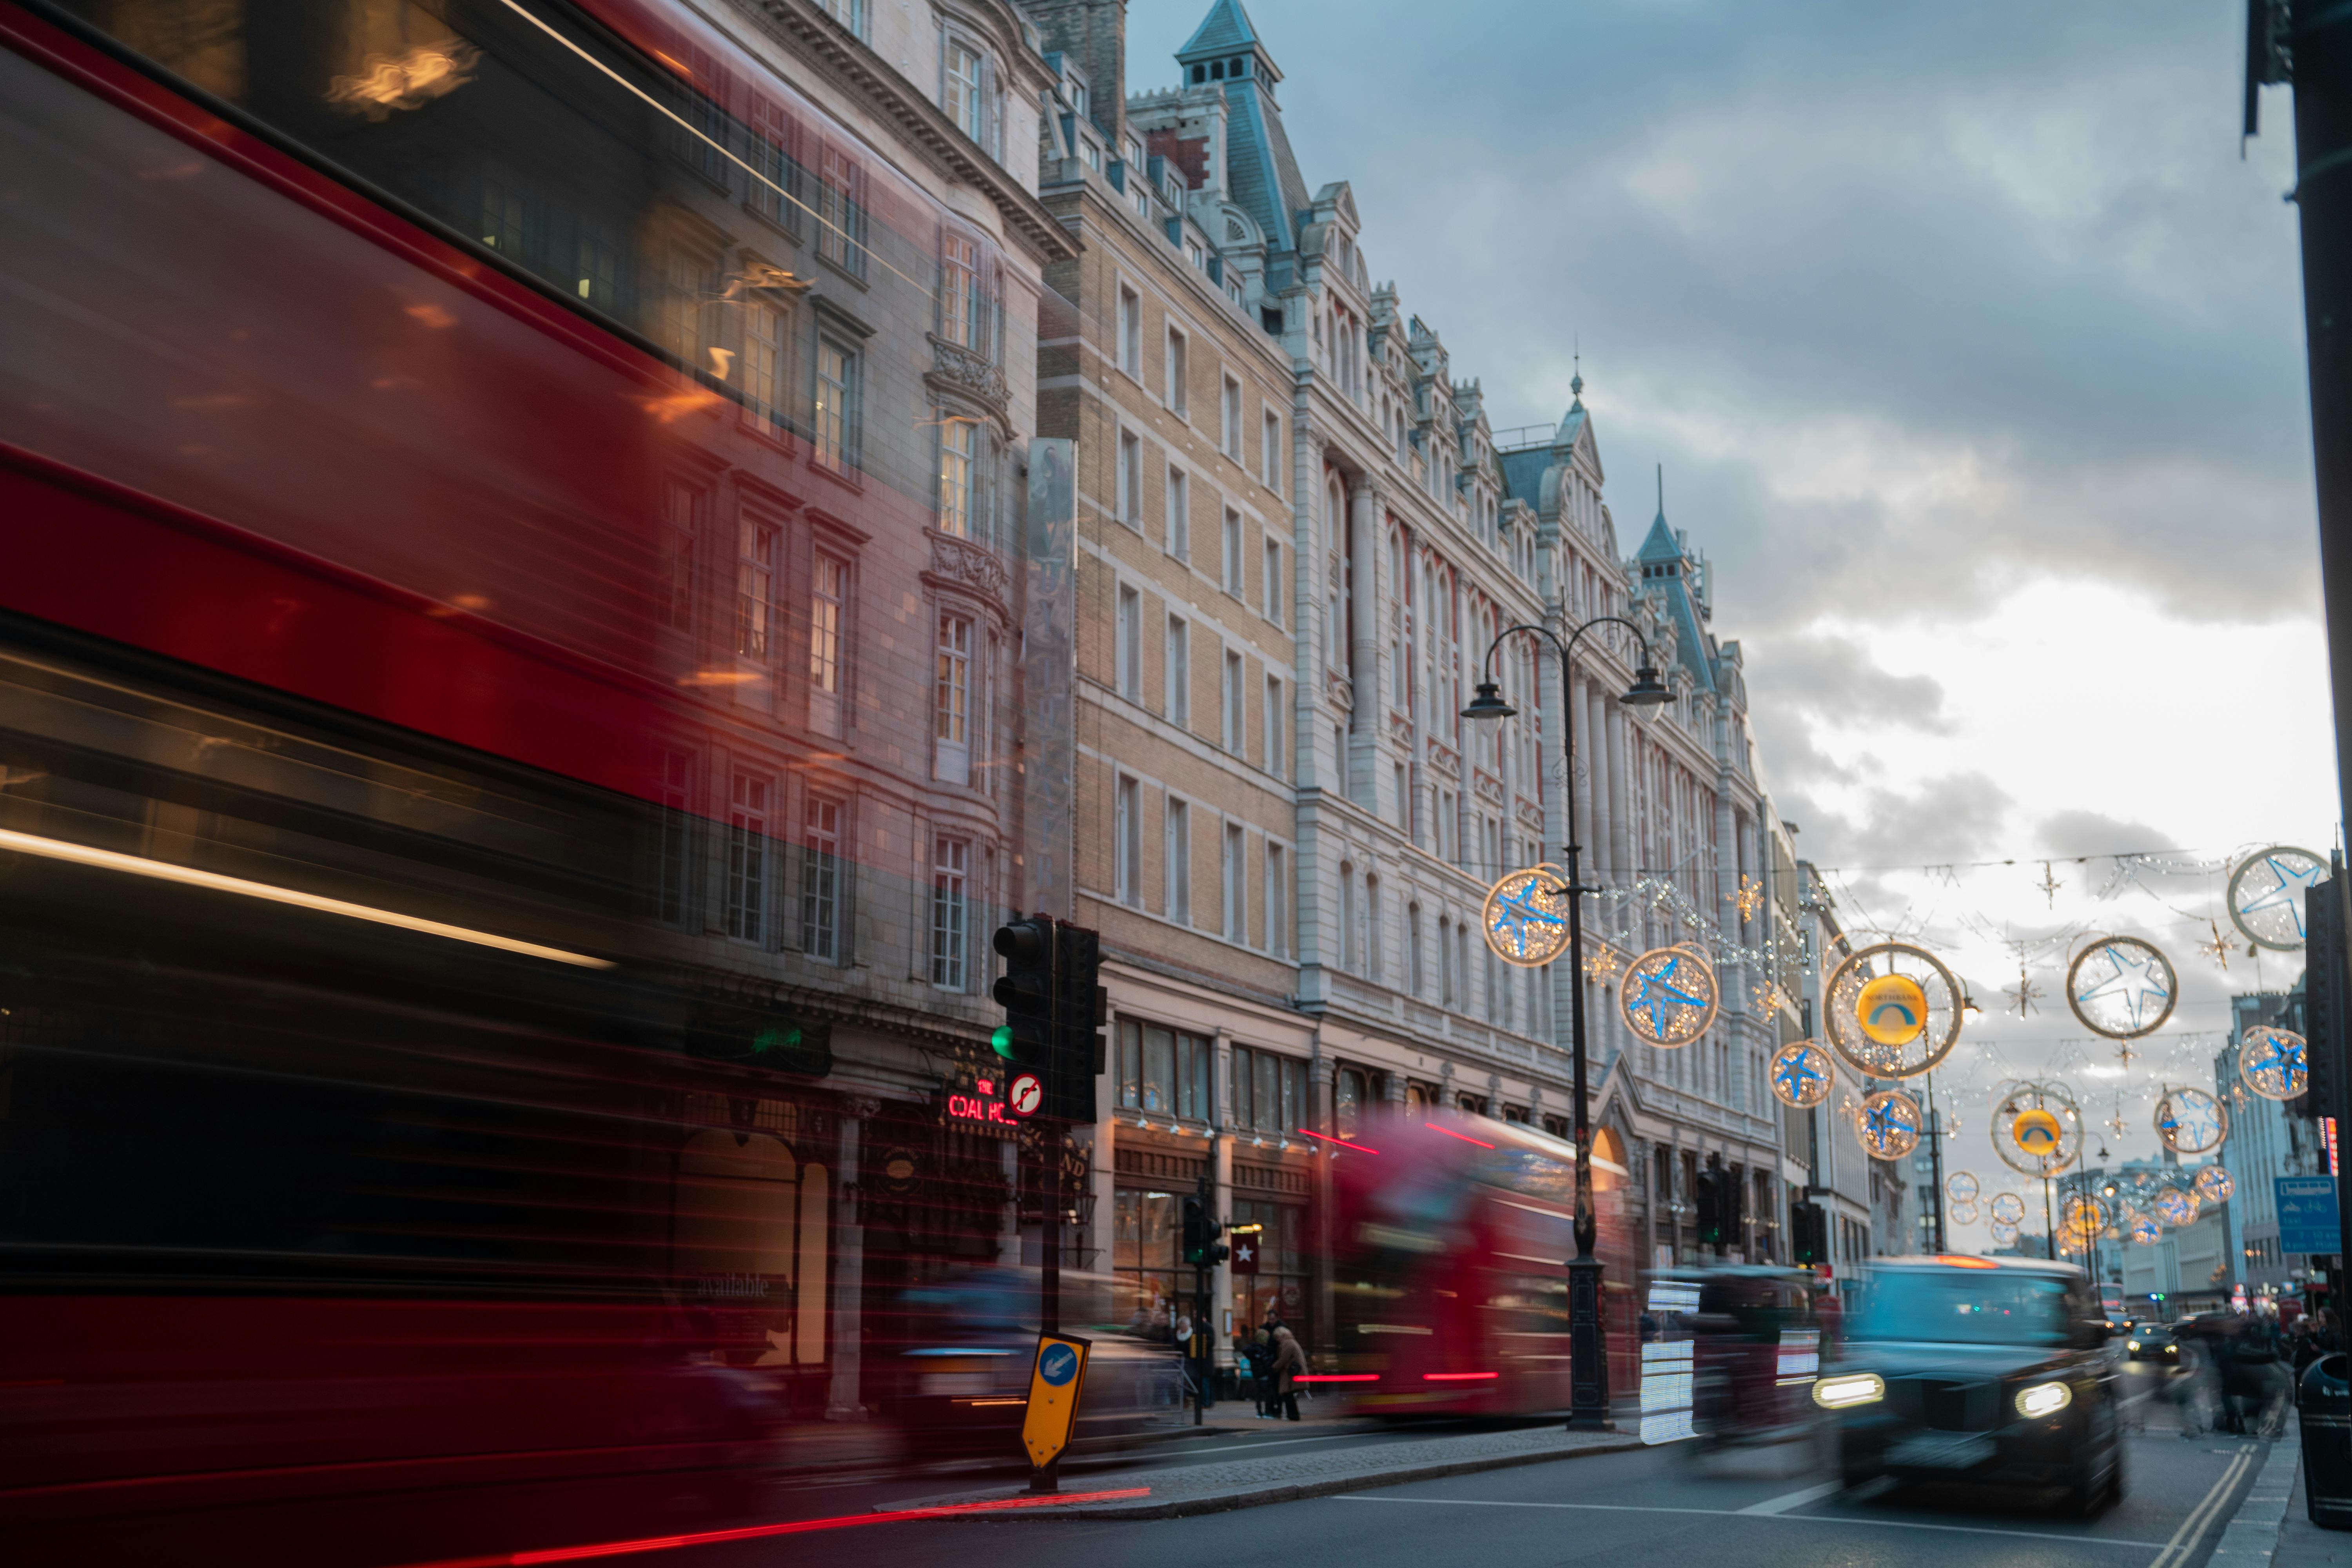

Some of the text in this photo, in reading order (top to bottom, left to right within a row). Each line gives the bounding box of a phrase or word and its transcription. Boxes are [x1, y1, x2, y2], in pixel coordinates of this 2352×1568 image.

[978, 1079, 994, 1095] THE
[949, 1095, 984, 1120] COAL
[698, 1272, 769, 1297] available
